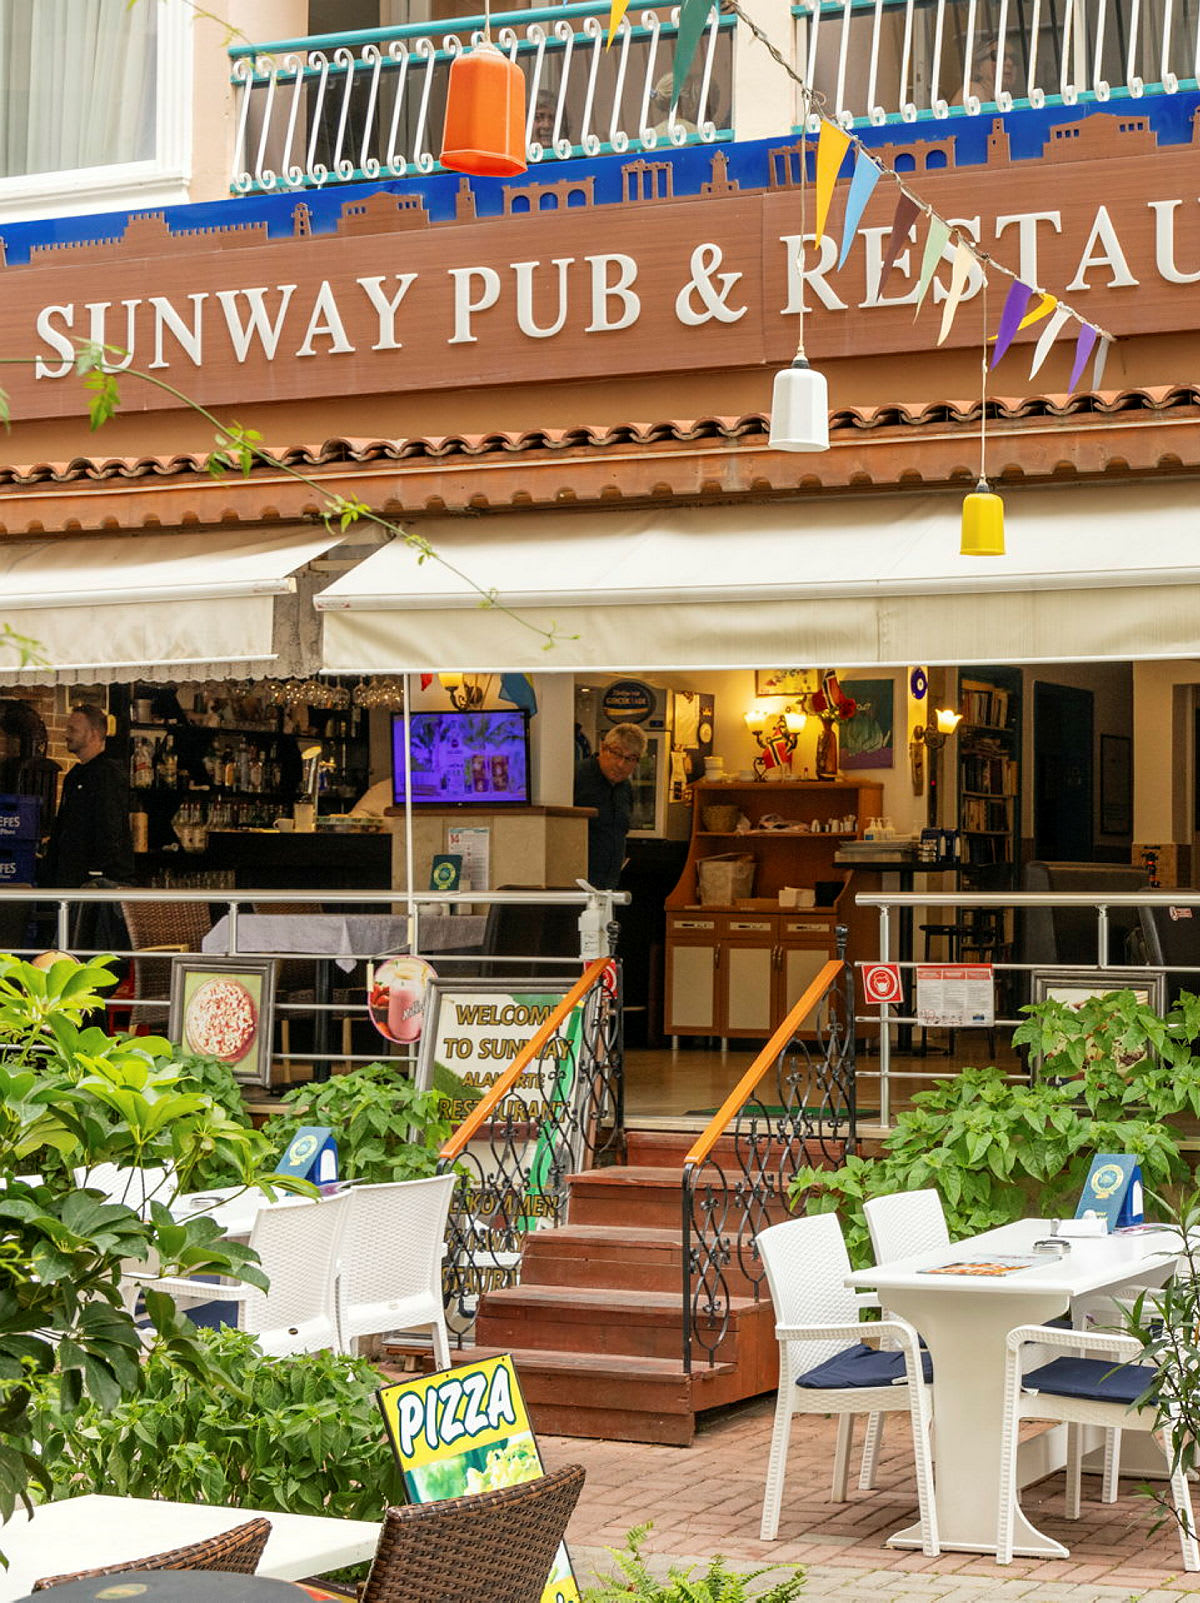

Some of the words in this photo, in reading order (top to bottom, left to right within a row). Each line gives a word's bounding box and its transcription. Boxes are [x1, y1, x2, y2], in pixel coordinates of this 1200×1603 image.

[35, 273, 418, 380] SUNWAY
[447, 253, 641, 344] PUB
[675, 243, 747, 326] &
[455, 1004, 560, 1027] WELCOM
[443, 1038, 473, 1060] TO
[461, 1071, 547, 1090] ALARTE
[397, 1363, 517, 1459] PIZZA
